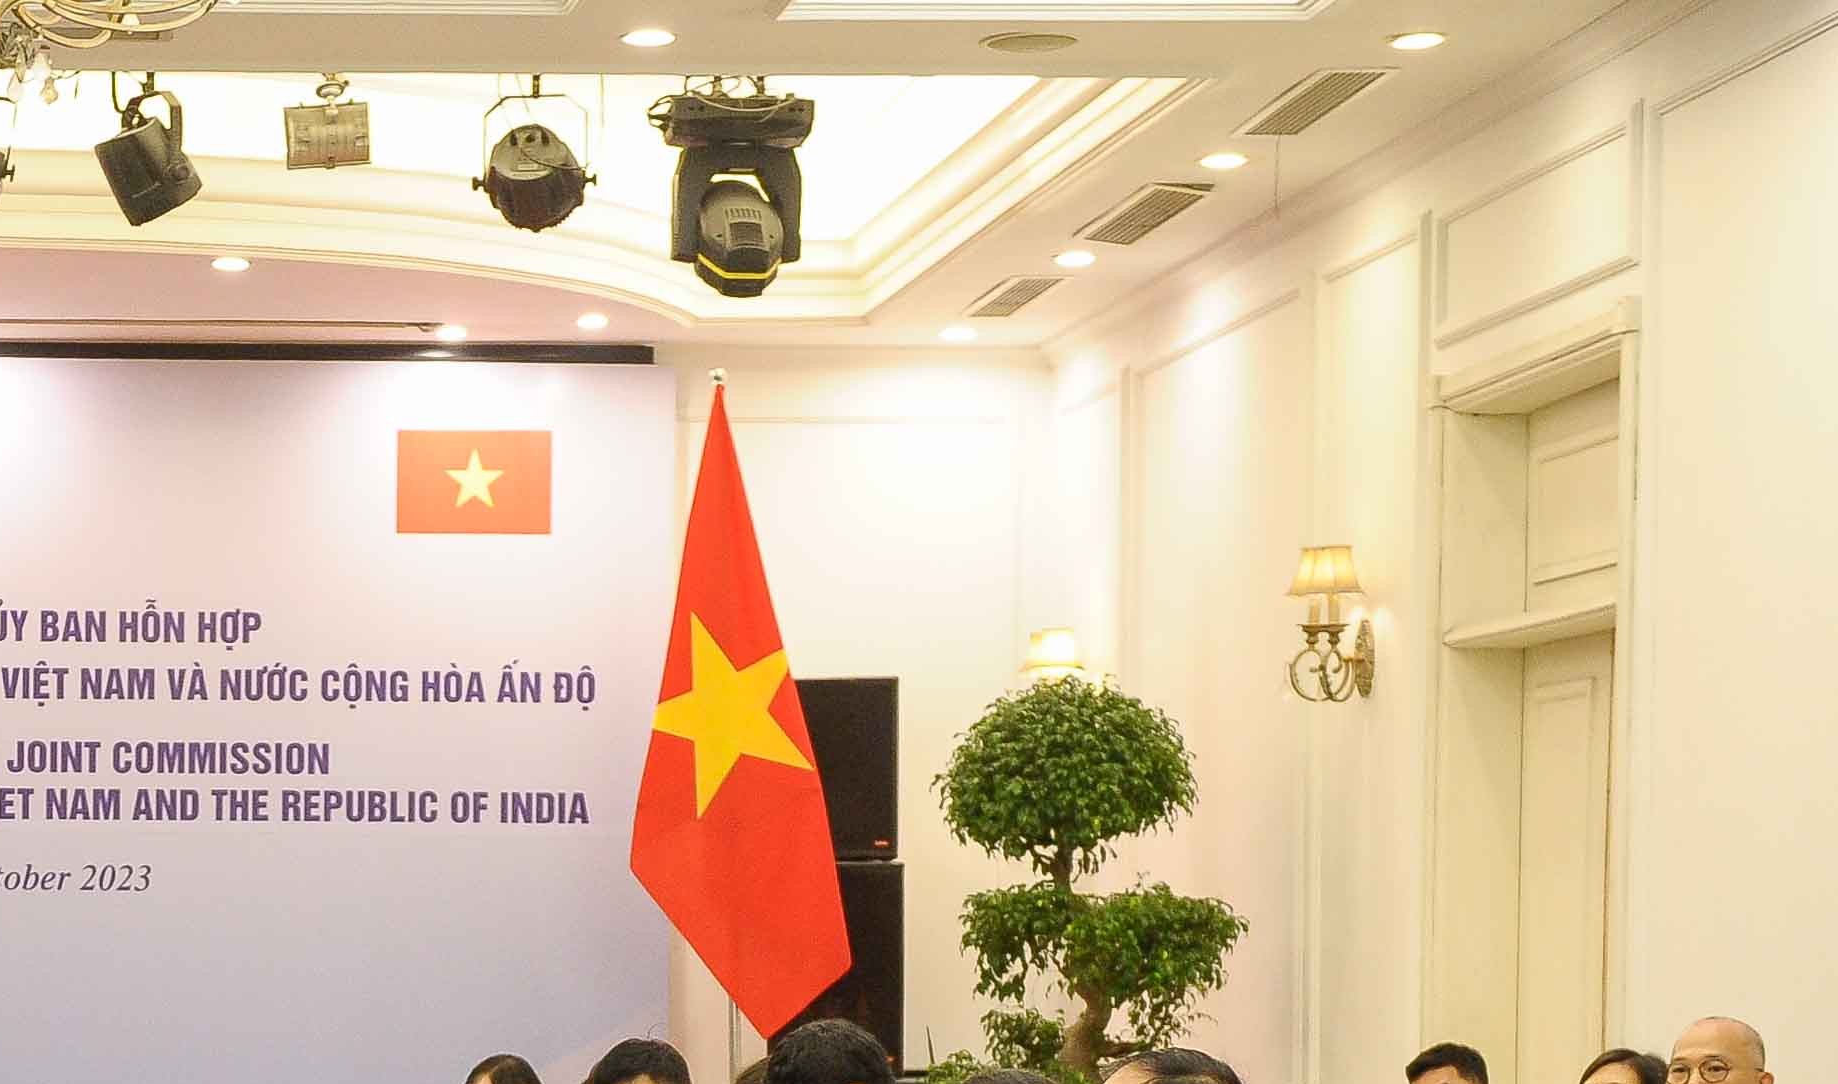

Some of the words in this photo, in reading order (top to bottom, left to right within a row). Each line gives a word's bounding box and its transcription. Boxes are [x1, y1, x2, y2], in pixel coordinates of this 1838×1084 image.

[39, 608, 107, 643] BAN
[118, 598, 186, 644] HỖN
[196, 608, 262, 652] HỢP
[0, 661, 69, 708] VIỆT
[79, 665, 157, 702] NAM
[166, 660, 210, 702] VÀ
[218, 660, 310, 703] NƯỚC
[319, 661, 410, 711] CỘNG
[419, 662, 487, 705] HÒA
[496, 658, 542, 705] ẤN
[552, 664, 597, 712] ĐỘ
[5, 740, 102, 775] JOINT
[110, 740, 332, 777] COMMISSION
[44, 787, 122, 822] NAM
[131, 788, 202, 823] AND
[210, 788, 270, 823] THE
[280, 789, 439, 825] REPUBLIC
[449, 791, 489, 825] OF
[499, 791, 591, 826] INDIA
[79, 863, 153, 894] 2023
